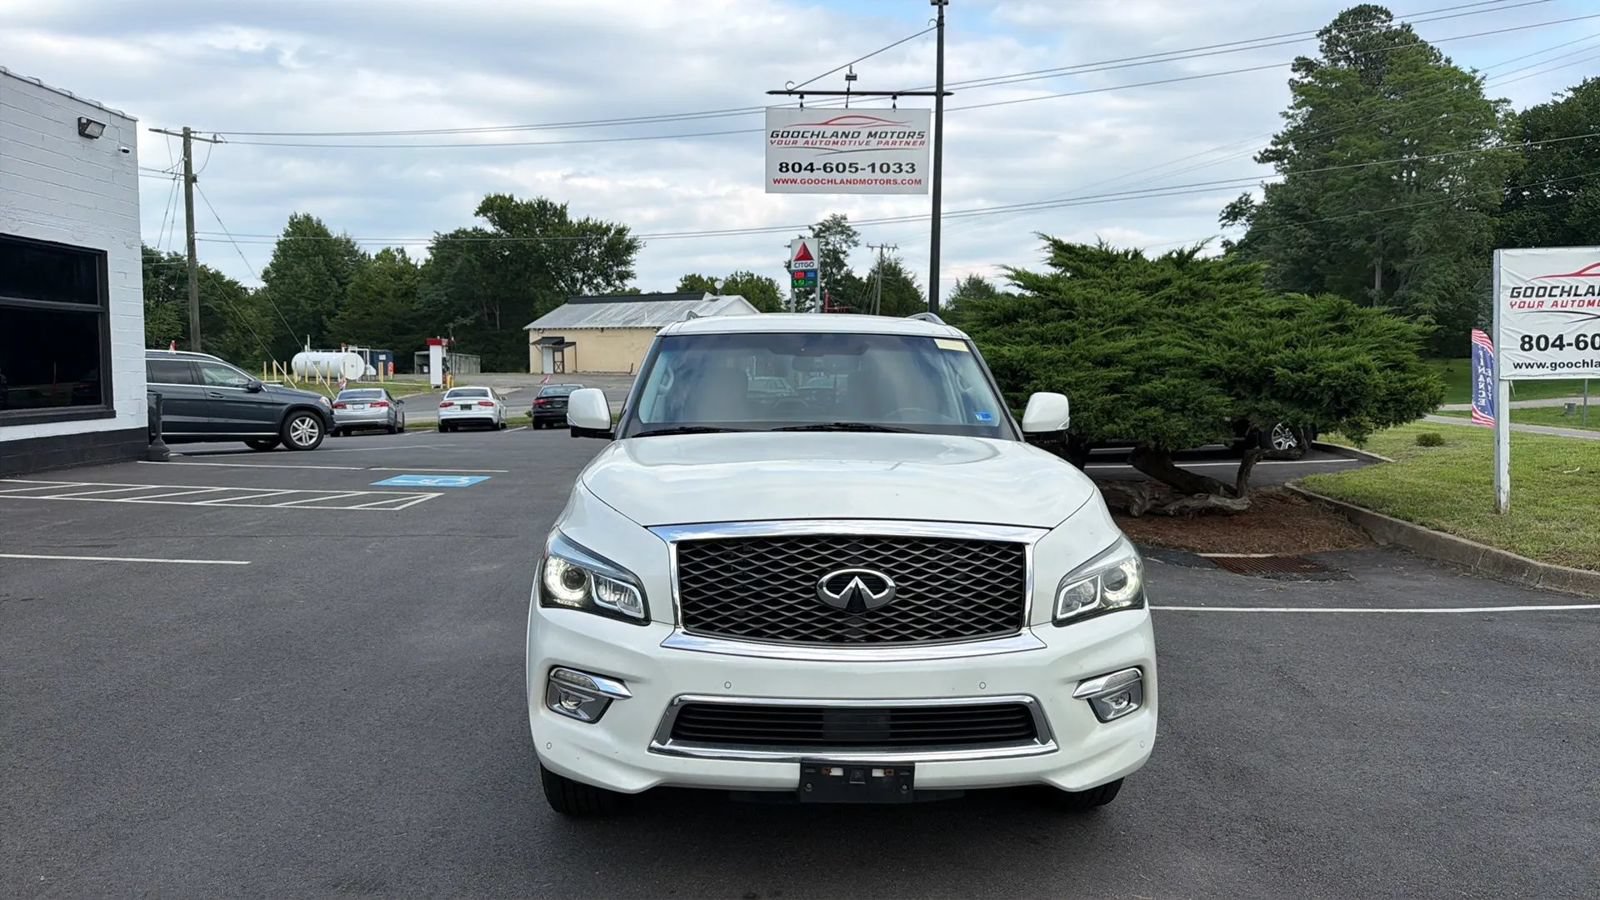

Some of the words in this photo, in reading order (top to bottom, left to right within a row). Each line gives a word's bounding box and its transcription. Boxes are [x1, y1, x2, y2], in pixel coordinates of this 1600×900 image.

[770, 130, 861, 139] GOOCHLAND
[867, 130, 926, 140] MOTORS
[778, 161, 917, 174] 804-605-1033
[772, 178, 923, 186] WWW.GOOCHLANDMOTORS.COM
[794, 261, 815, 269] CITGO
[1509, 285, 1600, 299] GOOCHLA
[1509, 300, 1545, 309] YOUR
[1550, 299, 1600, 308] AUTOM
